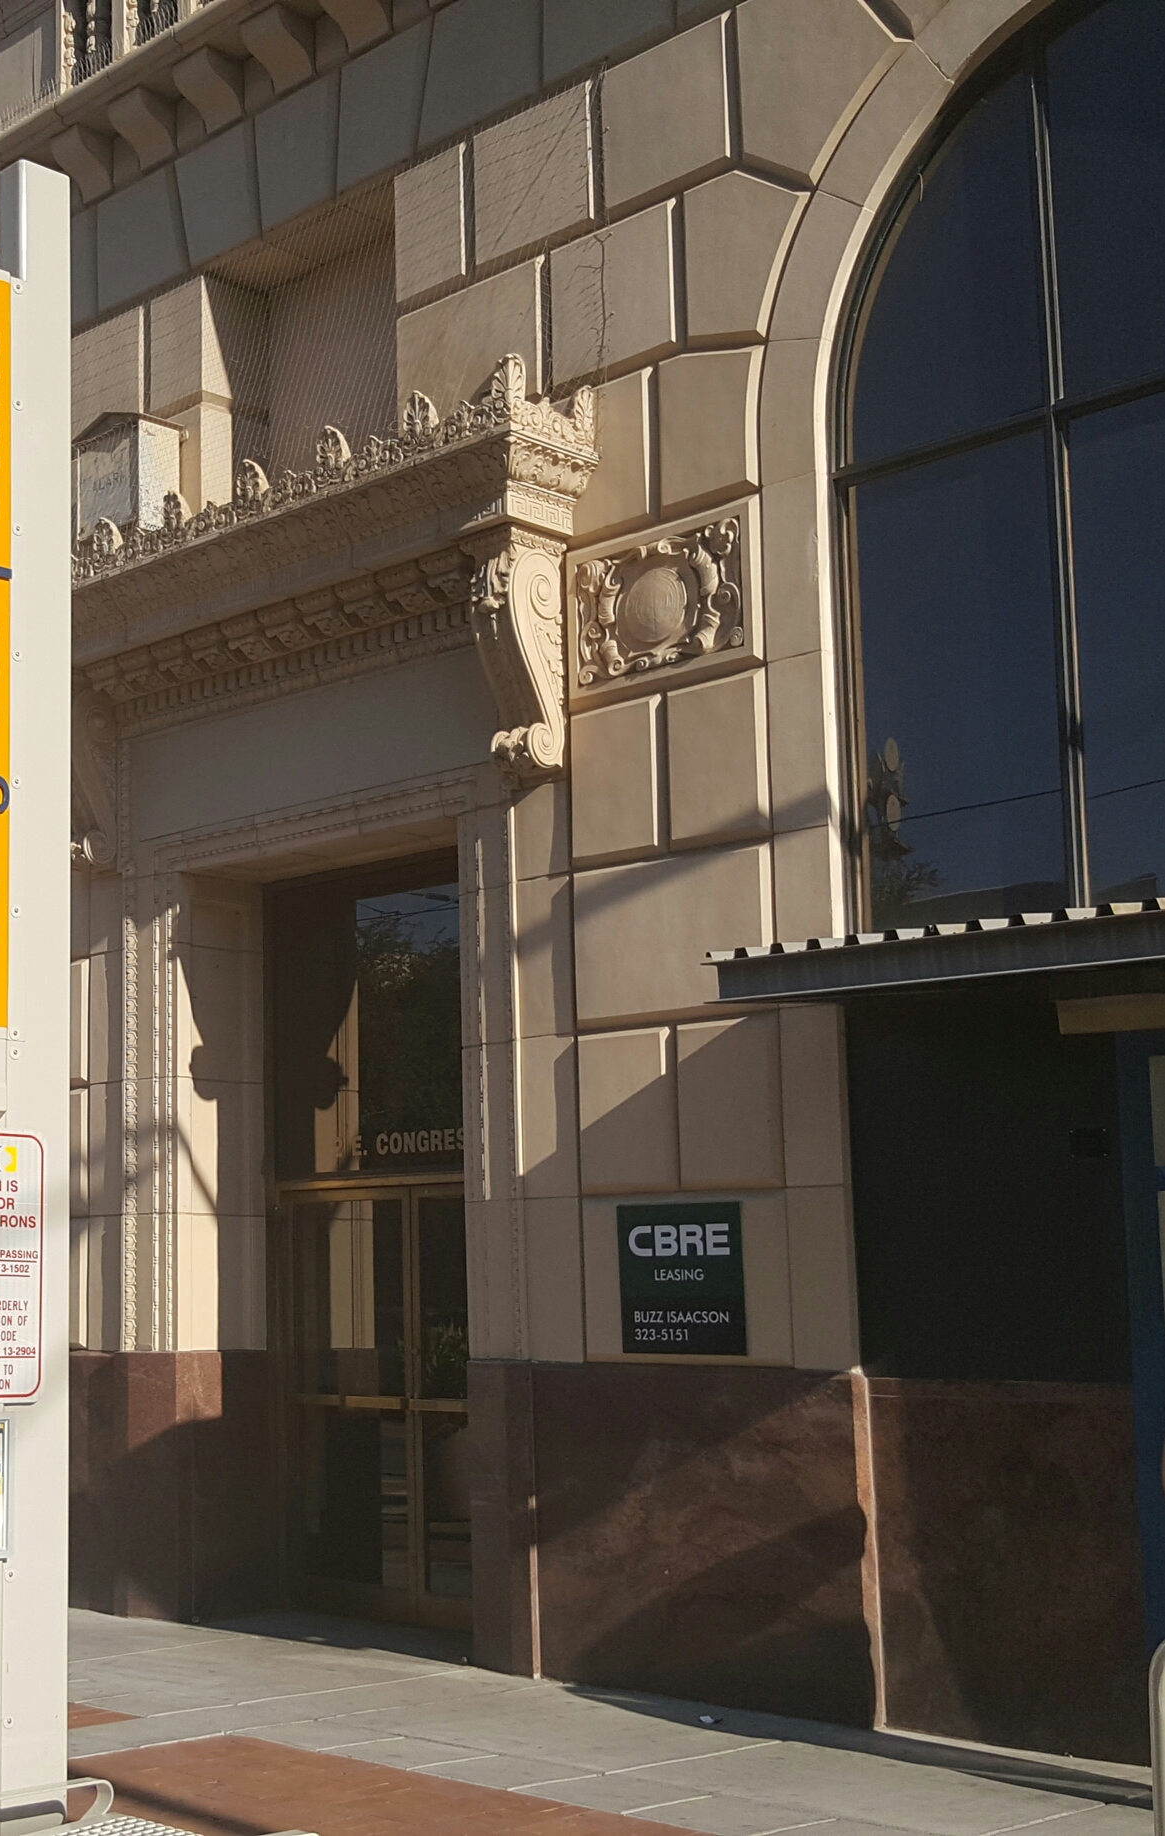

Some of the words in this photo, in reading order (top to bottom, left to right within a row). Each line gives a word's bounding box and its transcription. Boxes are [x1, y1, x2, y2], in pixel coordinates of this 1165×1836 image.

[7, 1180, 18, 1192] IS
[628, 1223, 730, 1257] CBRE
[654, 1268, 704, 1281] LEASING
[18, 1315, 28, 1326] OF
[634, 1311, 664, 1323] BUZZ
[667, 1311, 730, 1323] ISAACSON
[635, 1328, 689, 1341] 323-5151
[3, 1347, 36, 1355] 13-2904
[4, 1364, 13, 1375] TO
